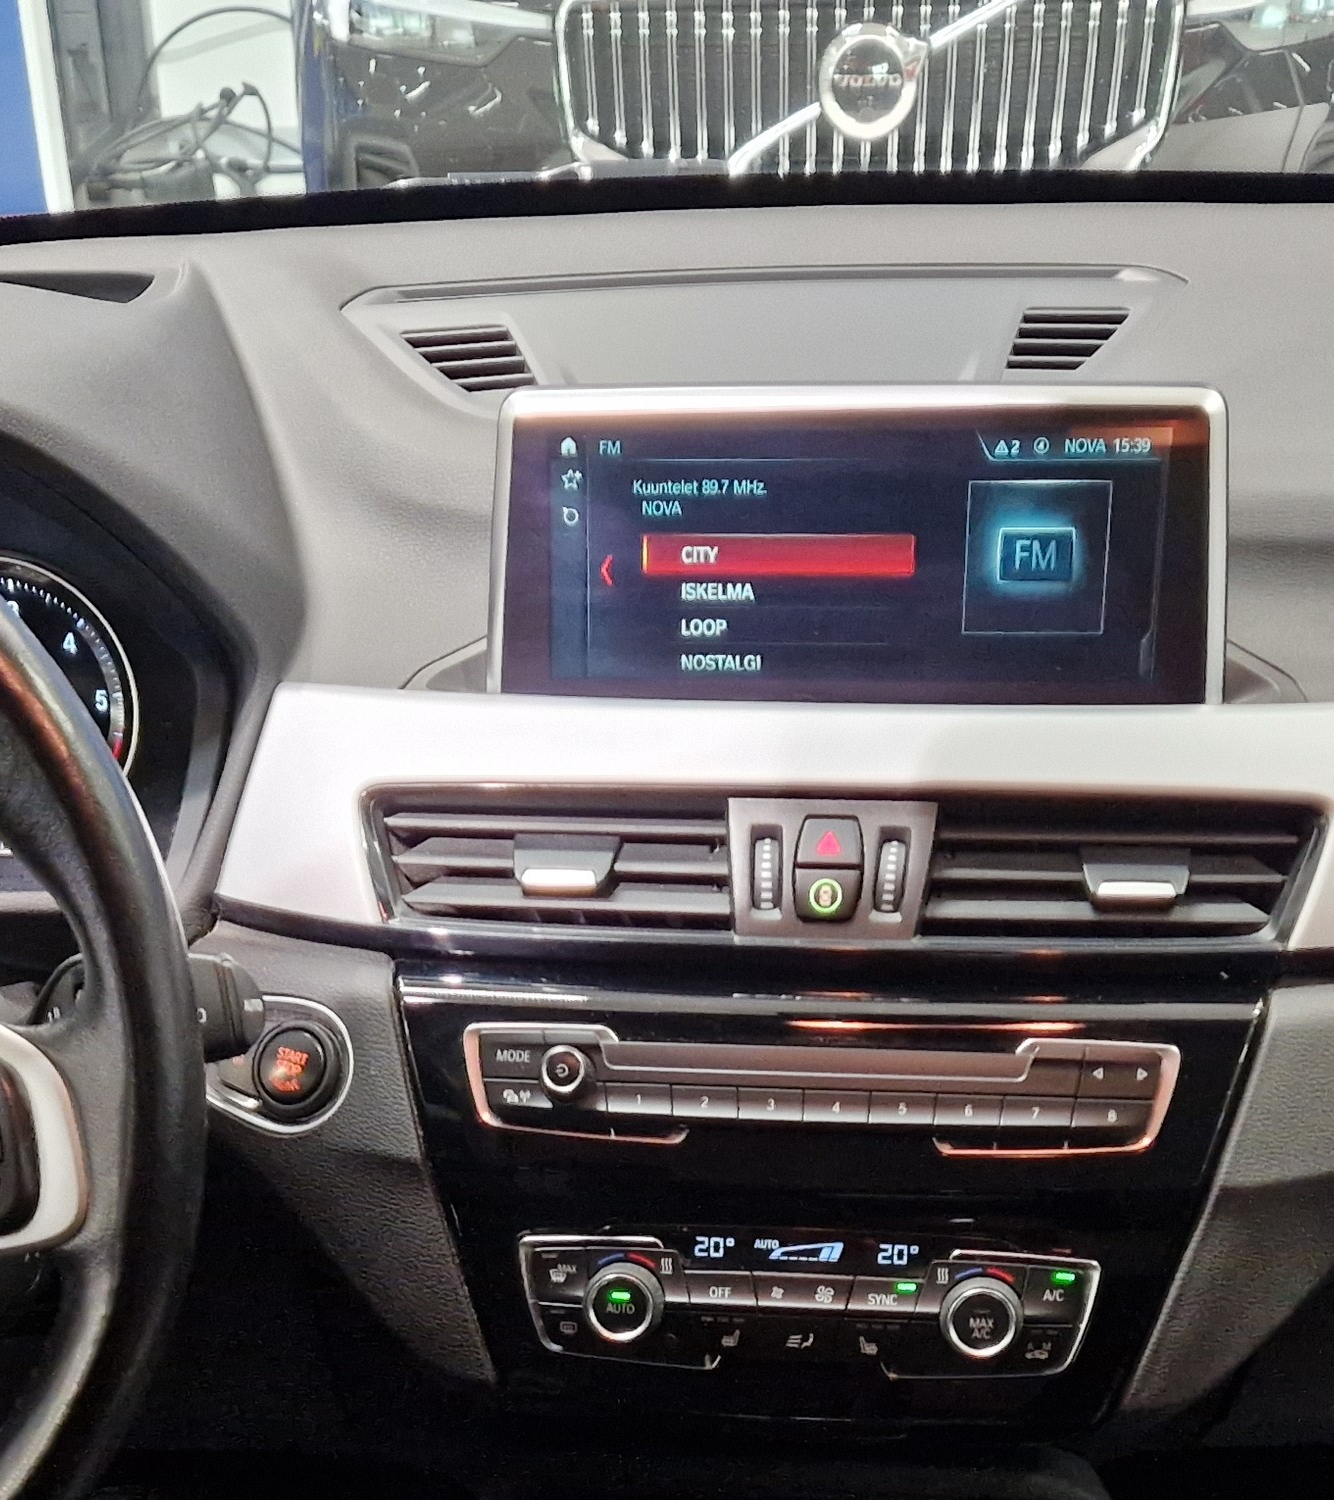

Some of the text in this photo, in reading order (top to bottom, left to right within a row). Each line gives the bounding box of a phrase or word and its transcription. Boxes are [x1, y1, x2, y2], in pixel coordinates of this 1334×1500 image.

[598, 440, 622, 455] FM
[1064, 438, 1152, 453] NOVA 15:39
[632, 479, 699, 495] Kuuntelet
[701, 479, 729, 495] 89.7
[641, 501, 683, 516] NOVA
[681, 546, 719, 564] CITY
[1015, 539, 1057, 571] FM
[680, 582, 756, 601] ISKELMA
[680, 618, 728, 637] LOOP
[62, 632, 78, 654] 4
[680, 654, 762, 671] NOSTALGI
[95, 689, 108, 712] 5
[496, 1048, 531, 1063] MODE
[635, 1093, 642, 1105] 1
[700, 1095, 709, 1108] 2
[766, 1097, 776, 1111] 3
[831, 1100, 842, 1113] 4
[897, 1102, 908, 1116] 5
[964, 1104, 974, 1117] 6
[1031, 1106, 1041, 1119] 7
[1106, 1109, 1118, 1123] 8
[753, 1239, 780, 1250] AUTO
[708, 1286, 732, 1298] OFF
[1042, 1289, 1065, 1302] A/C
[867, 1293, 899, 1306] SYNC
[605, 1303, 636, 1315] AUTO
[969, 1317, 994, 1328] MAX
[971, 1328, 991, 1339] A/C
